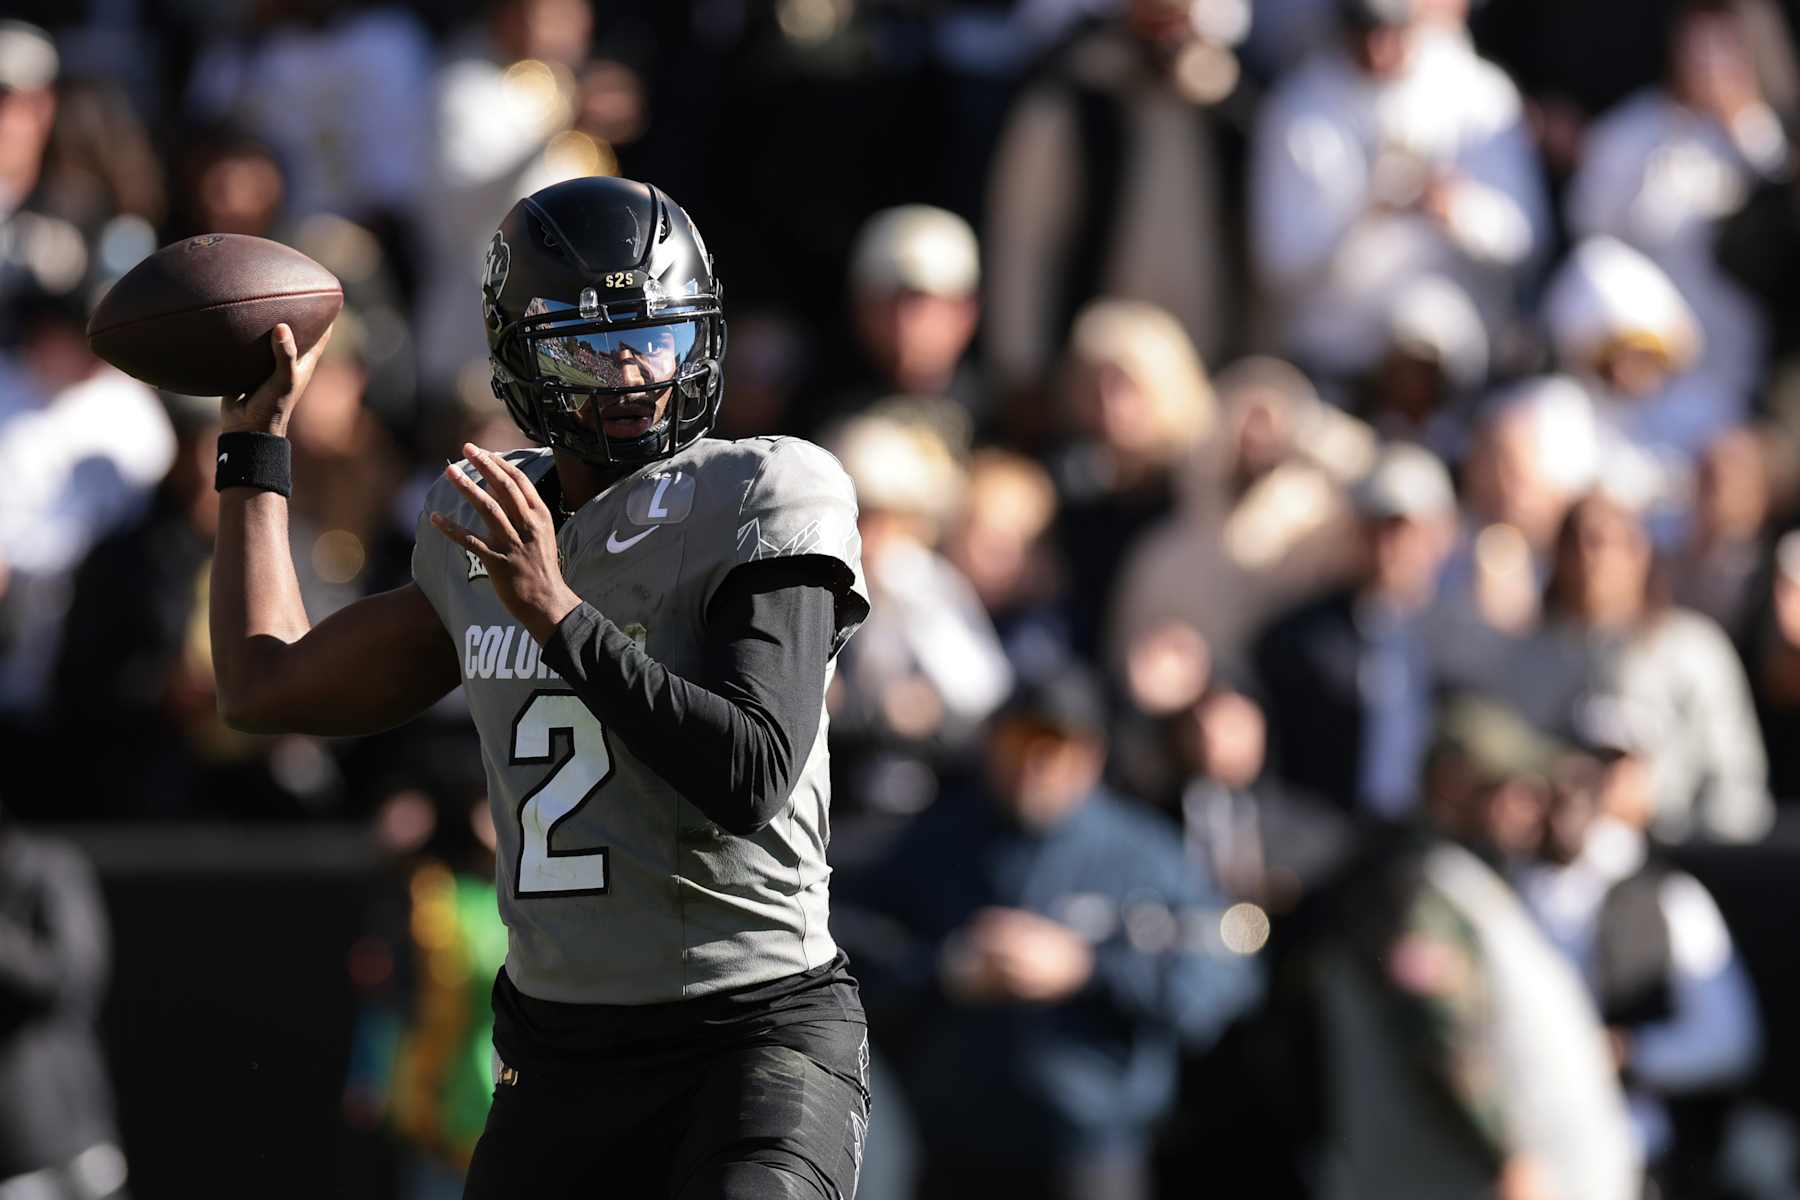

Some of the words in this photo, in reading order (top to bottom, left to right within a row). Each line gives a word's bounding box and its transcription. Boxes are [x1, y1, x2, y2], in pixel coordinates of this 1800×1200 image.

[605, 271, 634, 289] S2S
[465, 624, 562, 680] COLO
[509, 688, 615, 899] 2
